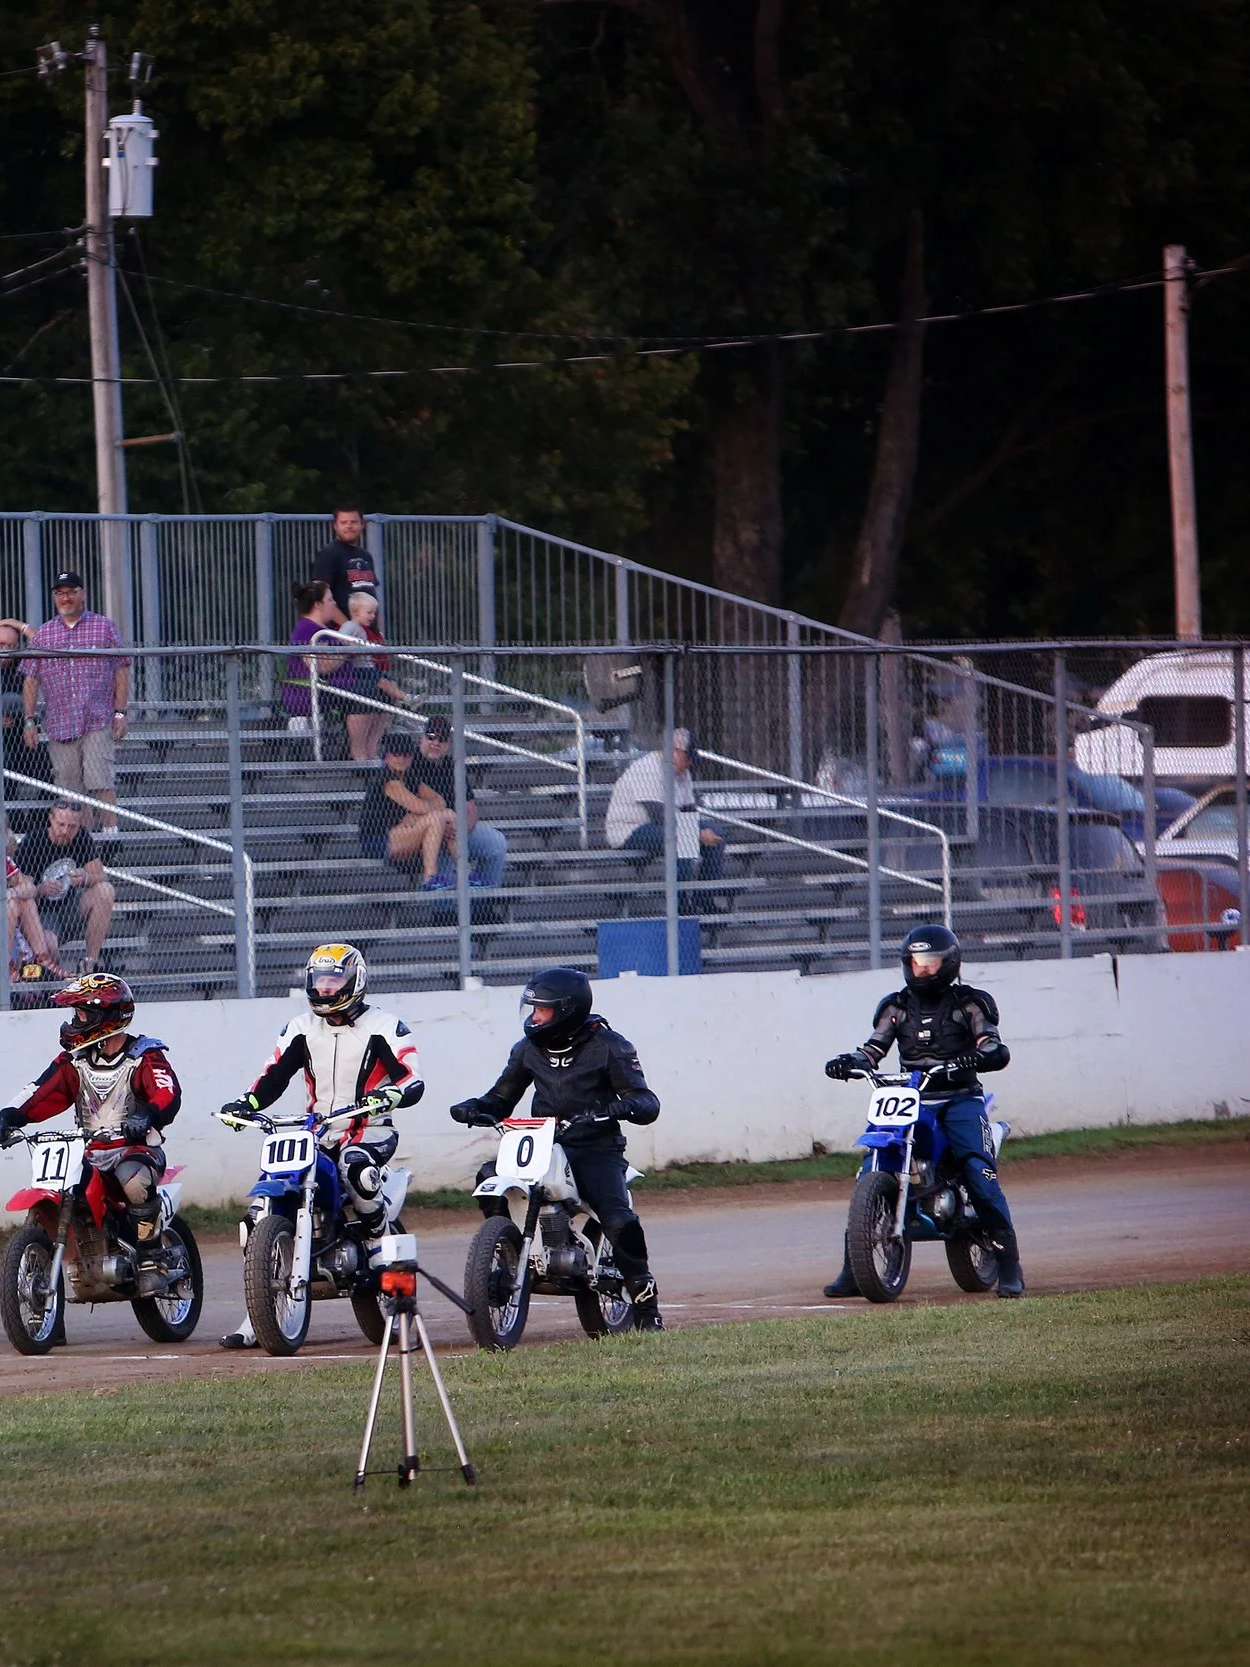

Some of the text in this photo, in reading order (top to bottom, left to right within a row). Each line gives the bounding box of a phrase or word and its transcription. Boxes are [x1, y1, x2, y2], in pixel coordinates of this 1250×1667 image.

[875, 1097, 916, 1117] 102
[36, 1147, 65, 1182] 11
[266, 1138, 308, 1164] 101
[517, 1135, 534, 1168] 0
